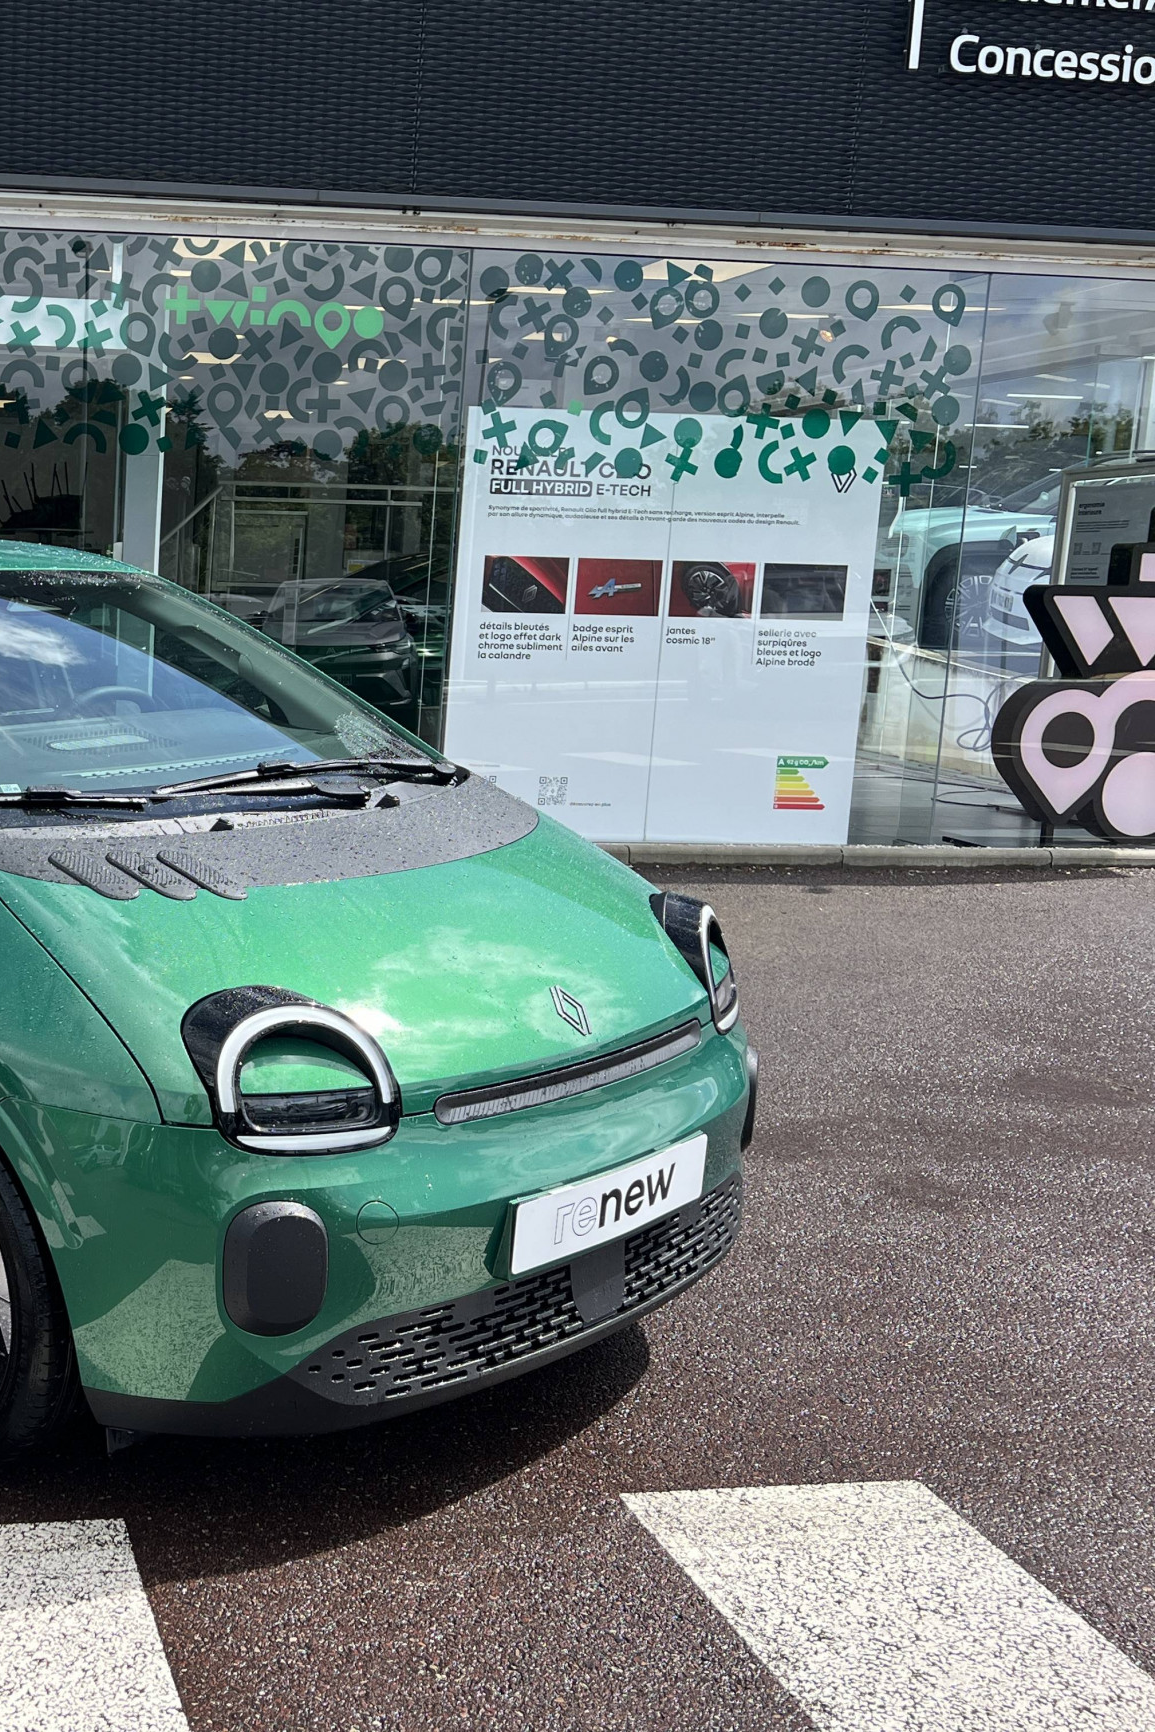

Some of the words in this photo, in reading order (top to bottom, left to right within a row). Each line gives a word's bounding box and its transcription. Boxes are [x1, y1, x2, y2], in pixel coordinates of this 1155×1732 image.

[950, 34, 1155, 85] Concessio
[599, 462, 651, 480] CO
[491, 480, 529, 494] FULL
[532, 481, 591, 495] HYBRID
[596, 484, 651, 497] E-TECH
[479, 621, 512, 630] détails
[514, 622, 550, 631] bleutés
[572, 623, 604, 634] badge
[605, 625, 634, 635] esprit
[666, 626, 696, 636] jantes
[478, 632, 489, 640] et
[490, 631, 512, 642] logo
[513, 632, 537, 640] effet
[538, 632, 561, 641] dark
[758, 628, 792, 637] sellerie
[572, 633, 603, 643] Alpine
[604, 635, 620, 643] sur
[621, 634, 635, 643] les
[666, 636, 700, 645] cosmic
[757, 638, 807, 648] surpiqûres
[478, 641, 514, 650] chrome
[516, 641, 563, 651] subliment
[571, 643, 594, 652] ailes
[595, 645, 624, 653] avant
[477, 650, 486, 659] la
[488, 651, 531, 660] calandre
[756, 647, 788, 656] bleues
[789, 649, 799, 657] et
[800, 648, 822, 659] logo
[755, 657, 786, 667] Alpine
[787, 658, 816, 667] brodé
[777, 758, 785, 766] A
[554, 1162, 676, 1245] renew
